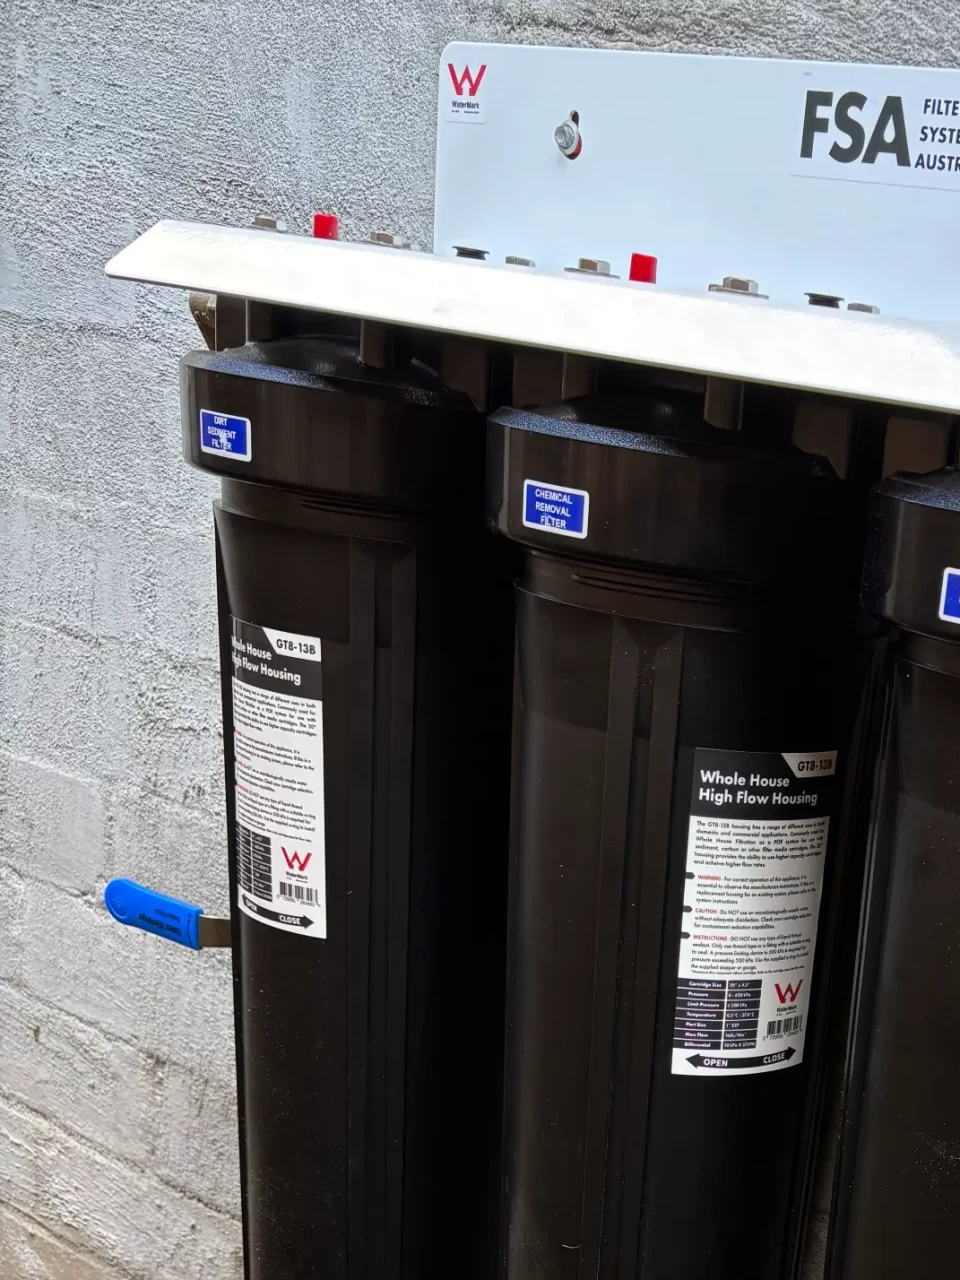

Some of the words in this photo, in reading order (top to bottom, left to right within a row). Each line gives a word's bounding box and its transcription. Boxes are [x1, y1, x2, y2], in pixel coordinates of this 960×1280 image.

[451, 100, 480, 109] WaterMark
[800, 90, 911, 167] FSA
[213, 415, 228, 426] DIRT
[211, 438, 232, 451] FILTER
[535, 488, 573, 504] CHEMICAL
[535, 501, 572, 517] REMOVAL
[540, 515, 567, 529] FILTER
[247, 642, 272, 661] House
[276, 638, 316, 655] GT8-13B
[243, 657, 259, 673] Flow
[261, 663, 301, 686] Housing
[277, 704, 297, 713] Commonly
[796, 758, 833, 773] GT8-13B
[700, 769, 747, 787] Whole
[749, 773, 790, 788] House
[698, 787, 733, 806] High
[736, 790, 769, 805] Flow
[772, 790, 818, 807] Housing
[279, 914, 302, 925] CLOSE
[689, 981, 711, 989] Cartridge
[703, 1058, 728, 1067] OPEN
[763, 1052, 785, 1064] CLOSE
